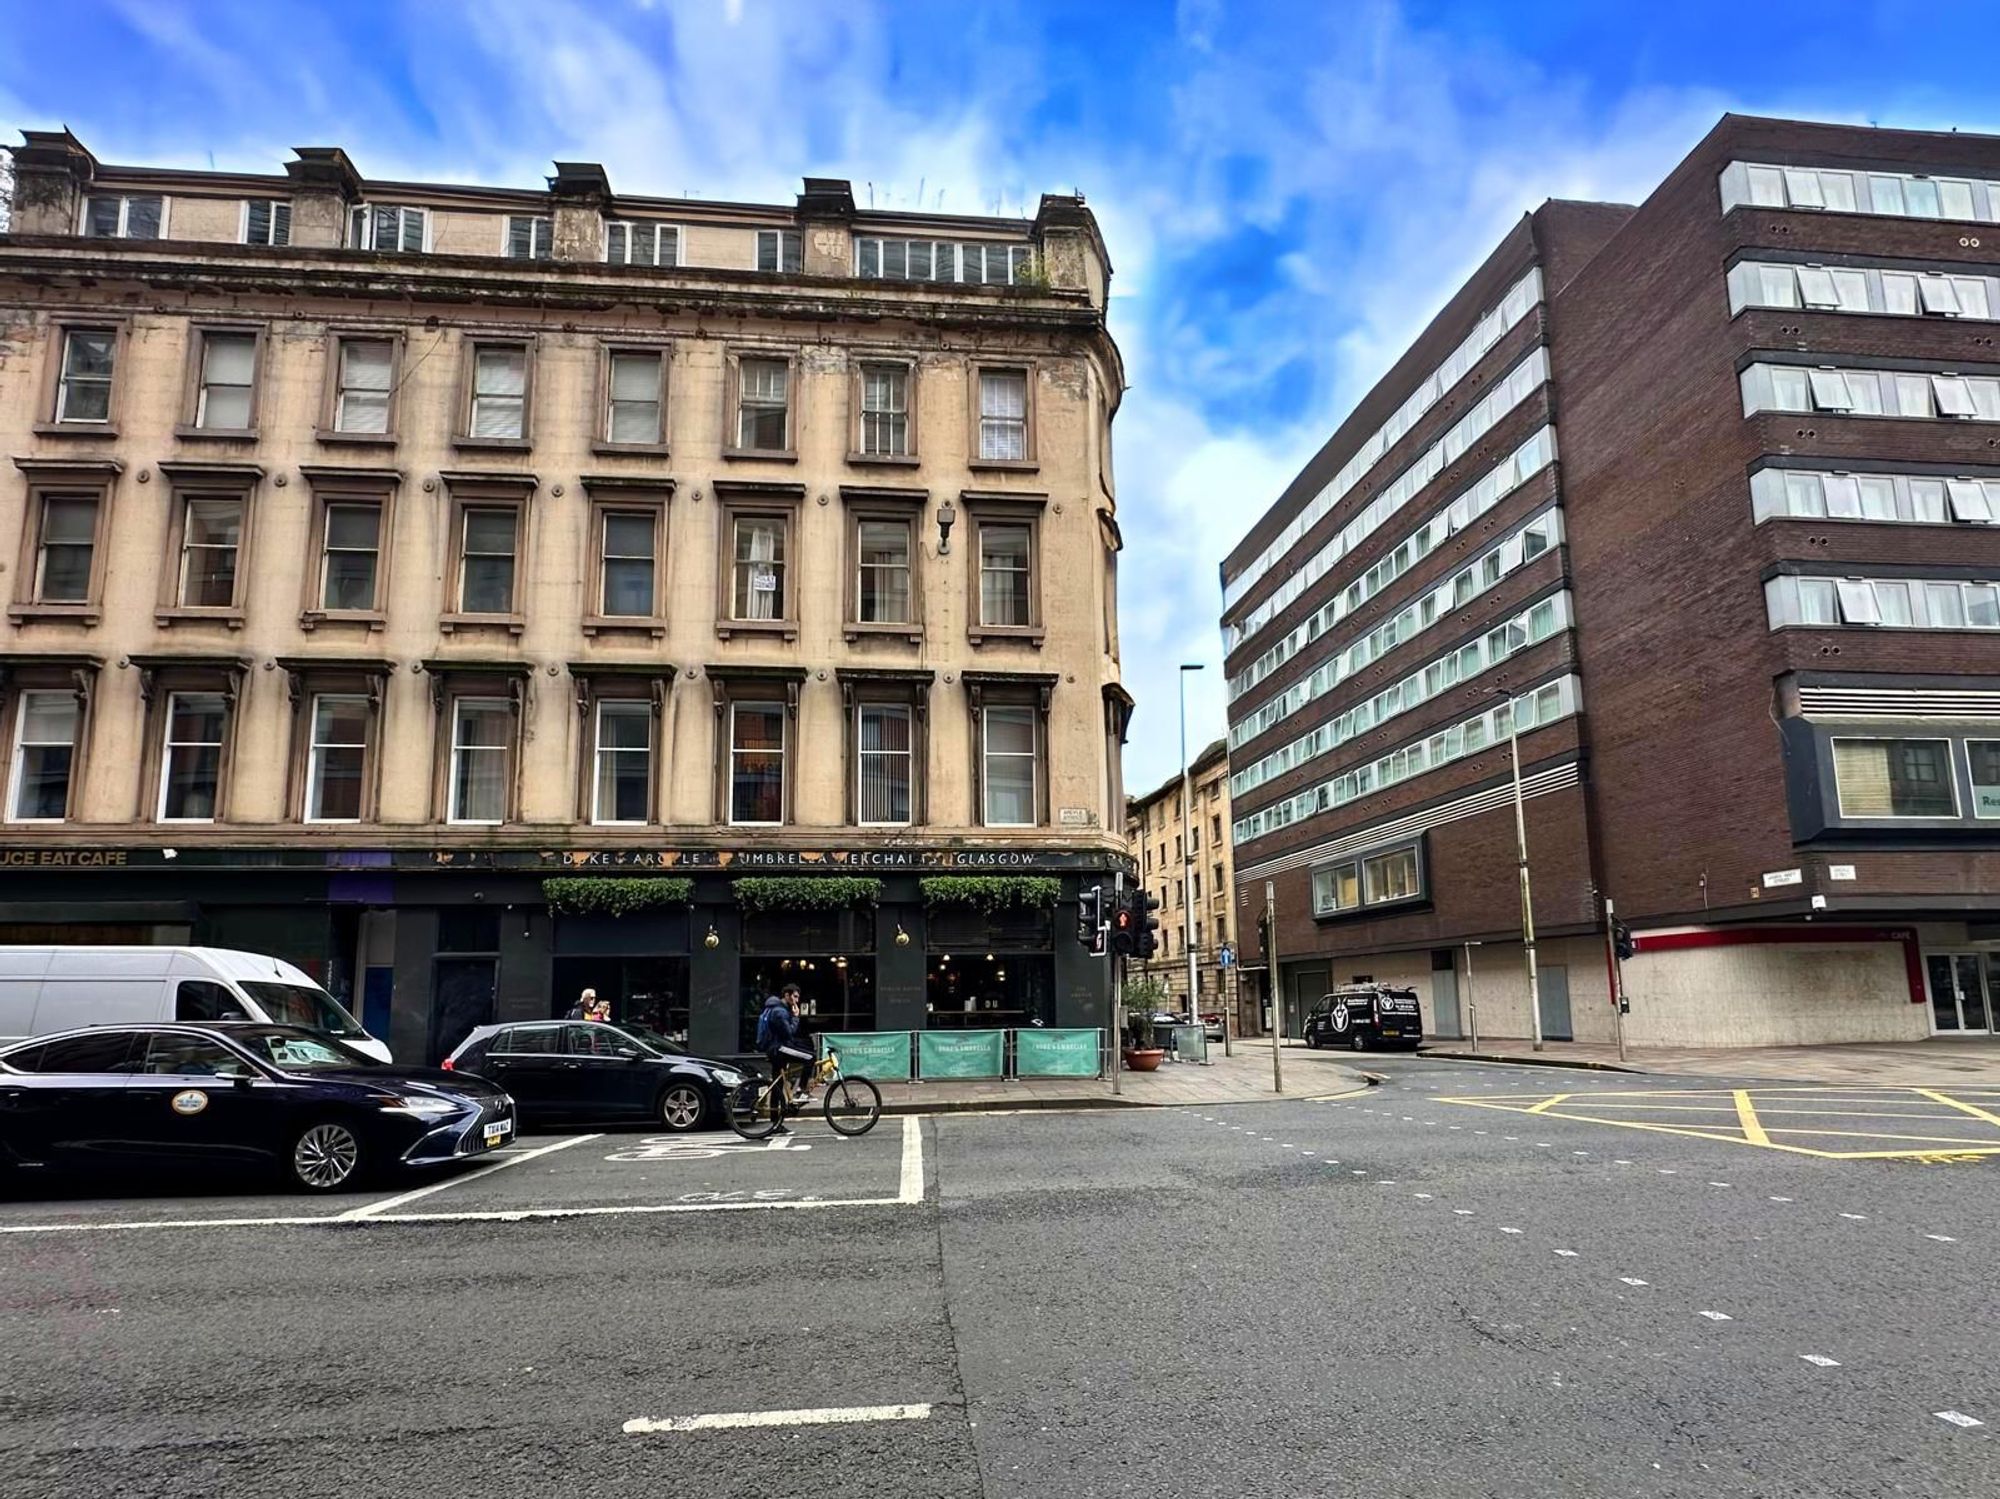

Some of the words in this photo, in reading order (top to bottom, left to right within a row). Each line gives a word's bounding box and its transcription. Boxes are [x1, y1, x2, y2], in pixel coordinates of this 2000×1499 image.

[41, 851, 76, 865] EAT
[77, 851, 127, 865] CAFE
[957, 853, 1034, 864] GLASGOW
